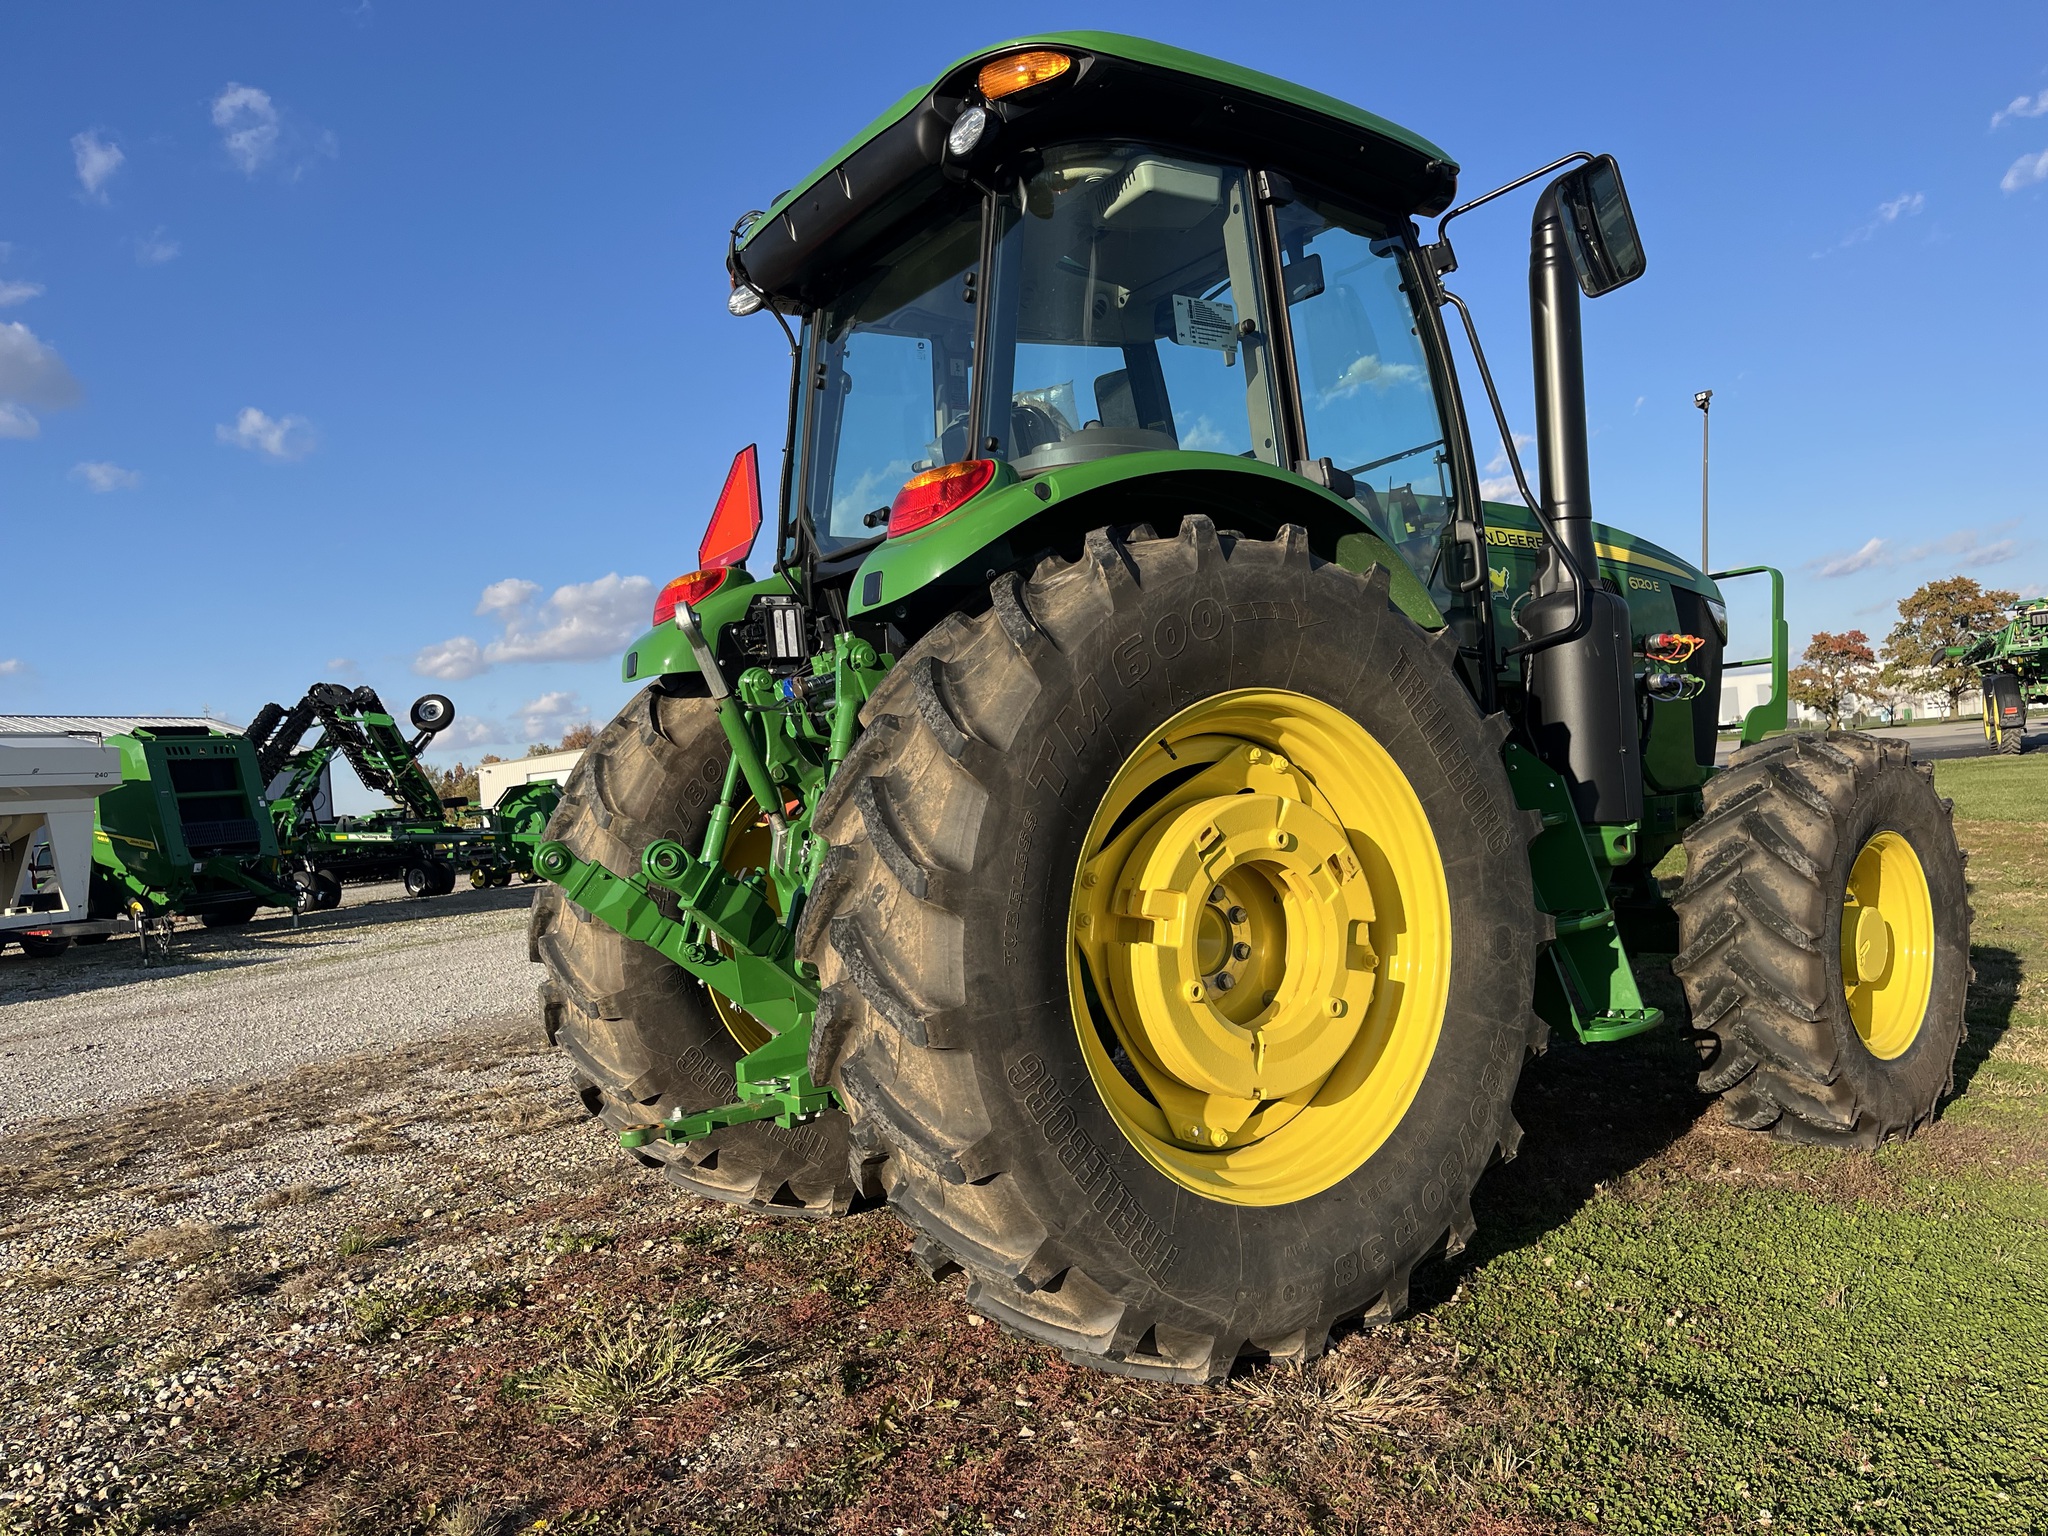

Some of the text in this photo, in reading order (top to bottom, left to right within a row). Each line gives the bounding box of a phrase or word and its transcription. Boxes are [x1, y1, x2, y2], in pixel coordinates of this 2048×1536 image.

[1497, 531, 1543, 548] DEERE
[1388, 645, 1512, 856] TRELLEBORG
[1003, 811, 1038, 966] TUBELESS
[1006, 1052, 1179, 1290] TRELLEBORG
[1403, 1121, 1436, 1166] 18.4
[1422, 1030, 1509, 1213] 480/80
[1335, 1234, 1386, 1289] 38
[1391, 1204, 1420, 1246] R
